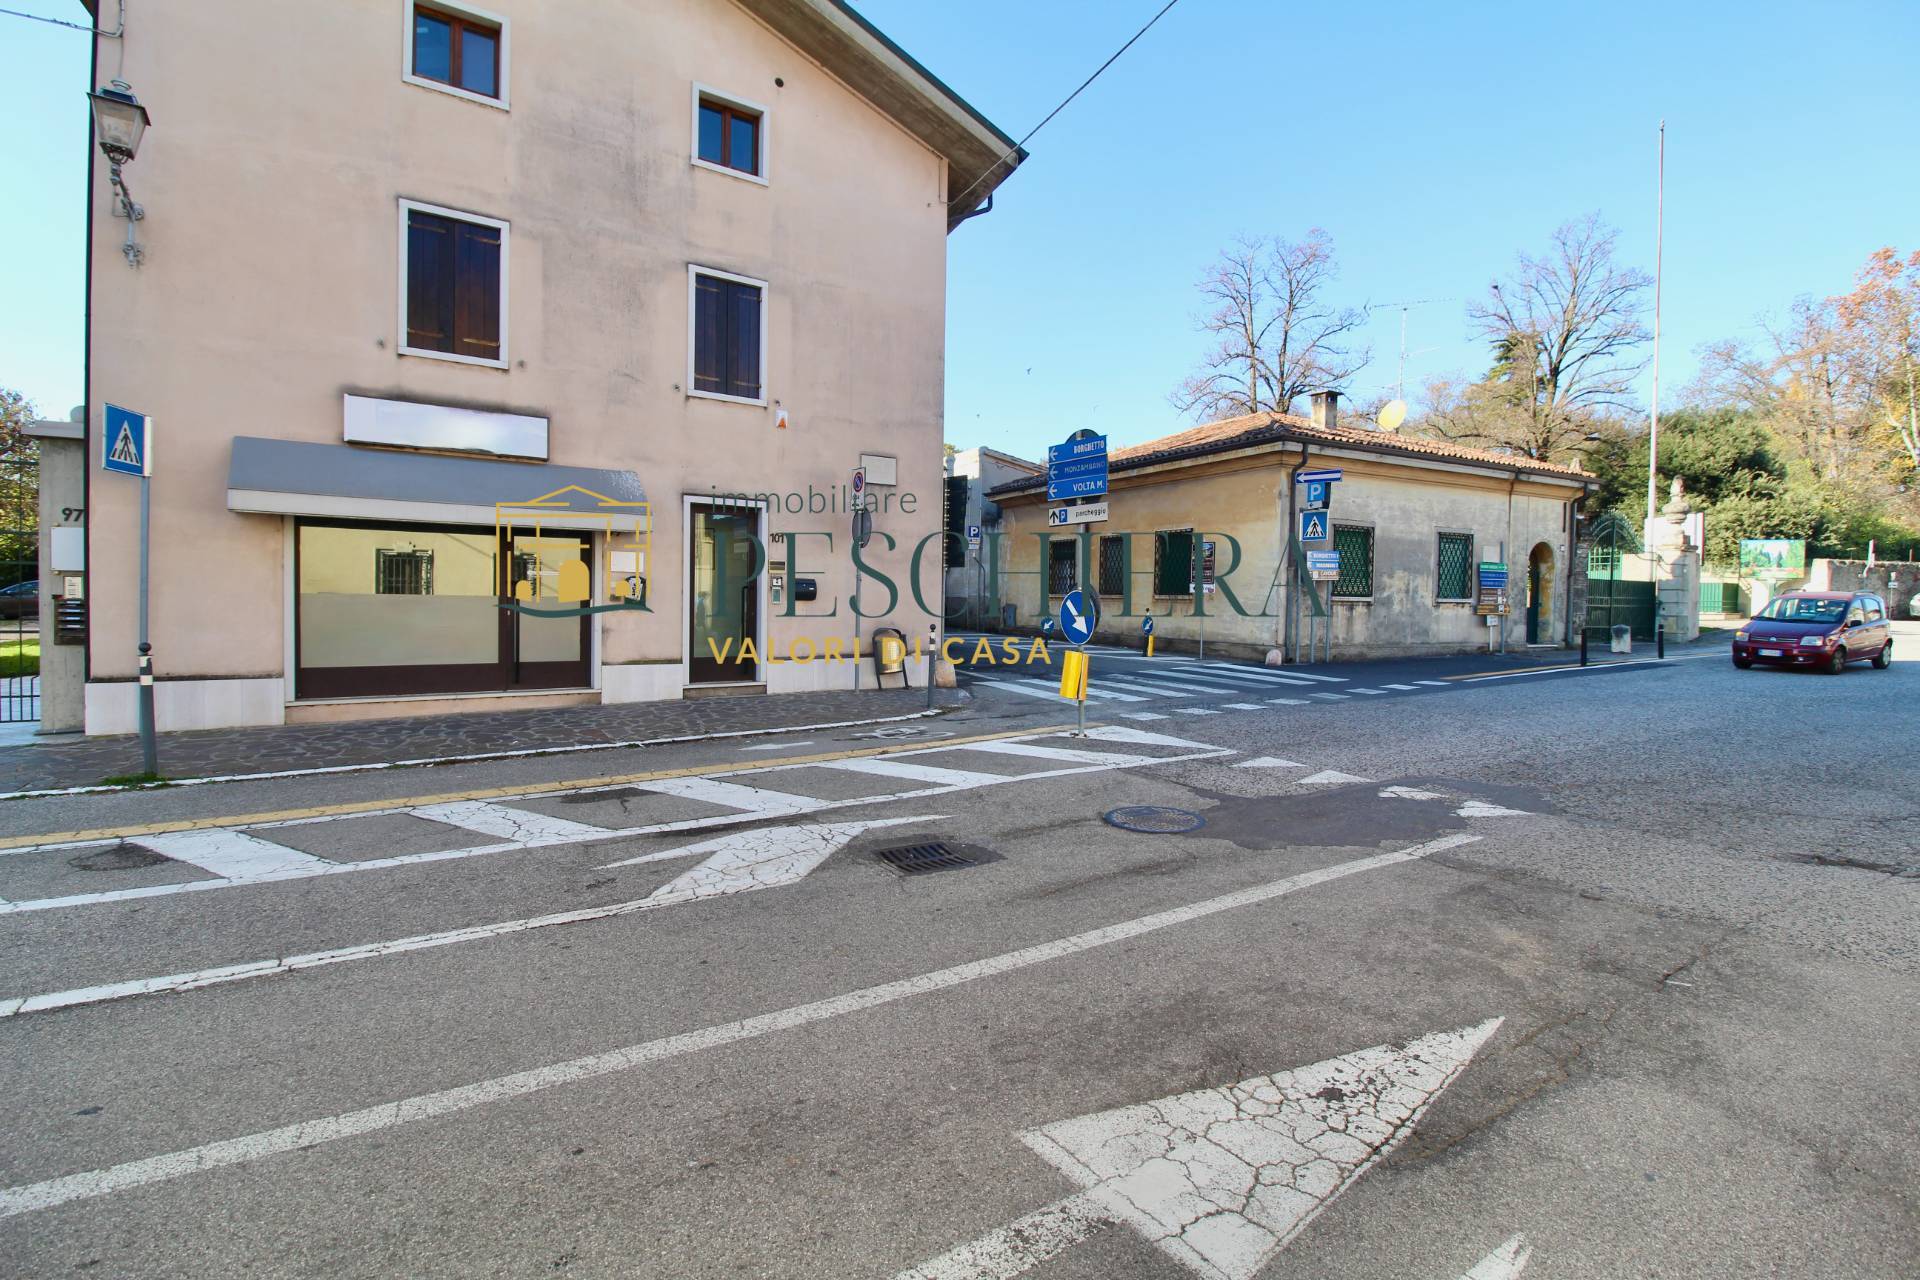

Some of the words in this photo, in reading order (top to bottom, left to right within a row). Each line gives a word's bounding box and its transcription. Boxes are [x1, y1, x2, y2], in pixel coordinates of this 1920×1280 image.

[1073, 440, 1105, 454] BORGHETTO
[1073, 481, 1095, 492] VOLTA
[1096, 479, 1104, 489] M.
[62, 508, 83, 521] 97
[1075, 508, 1106, 518] parcheggio
[770, 533, 784, 544] 101
